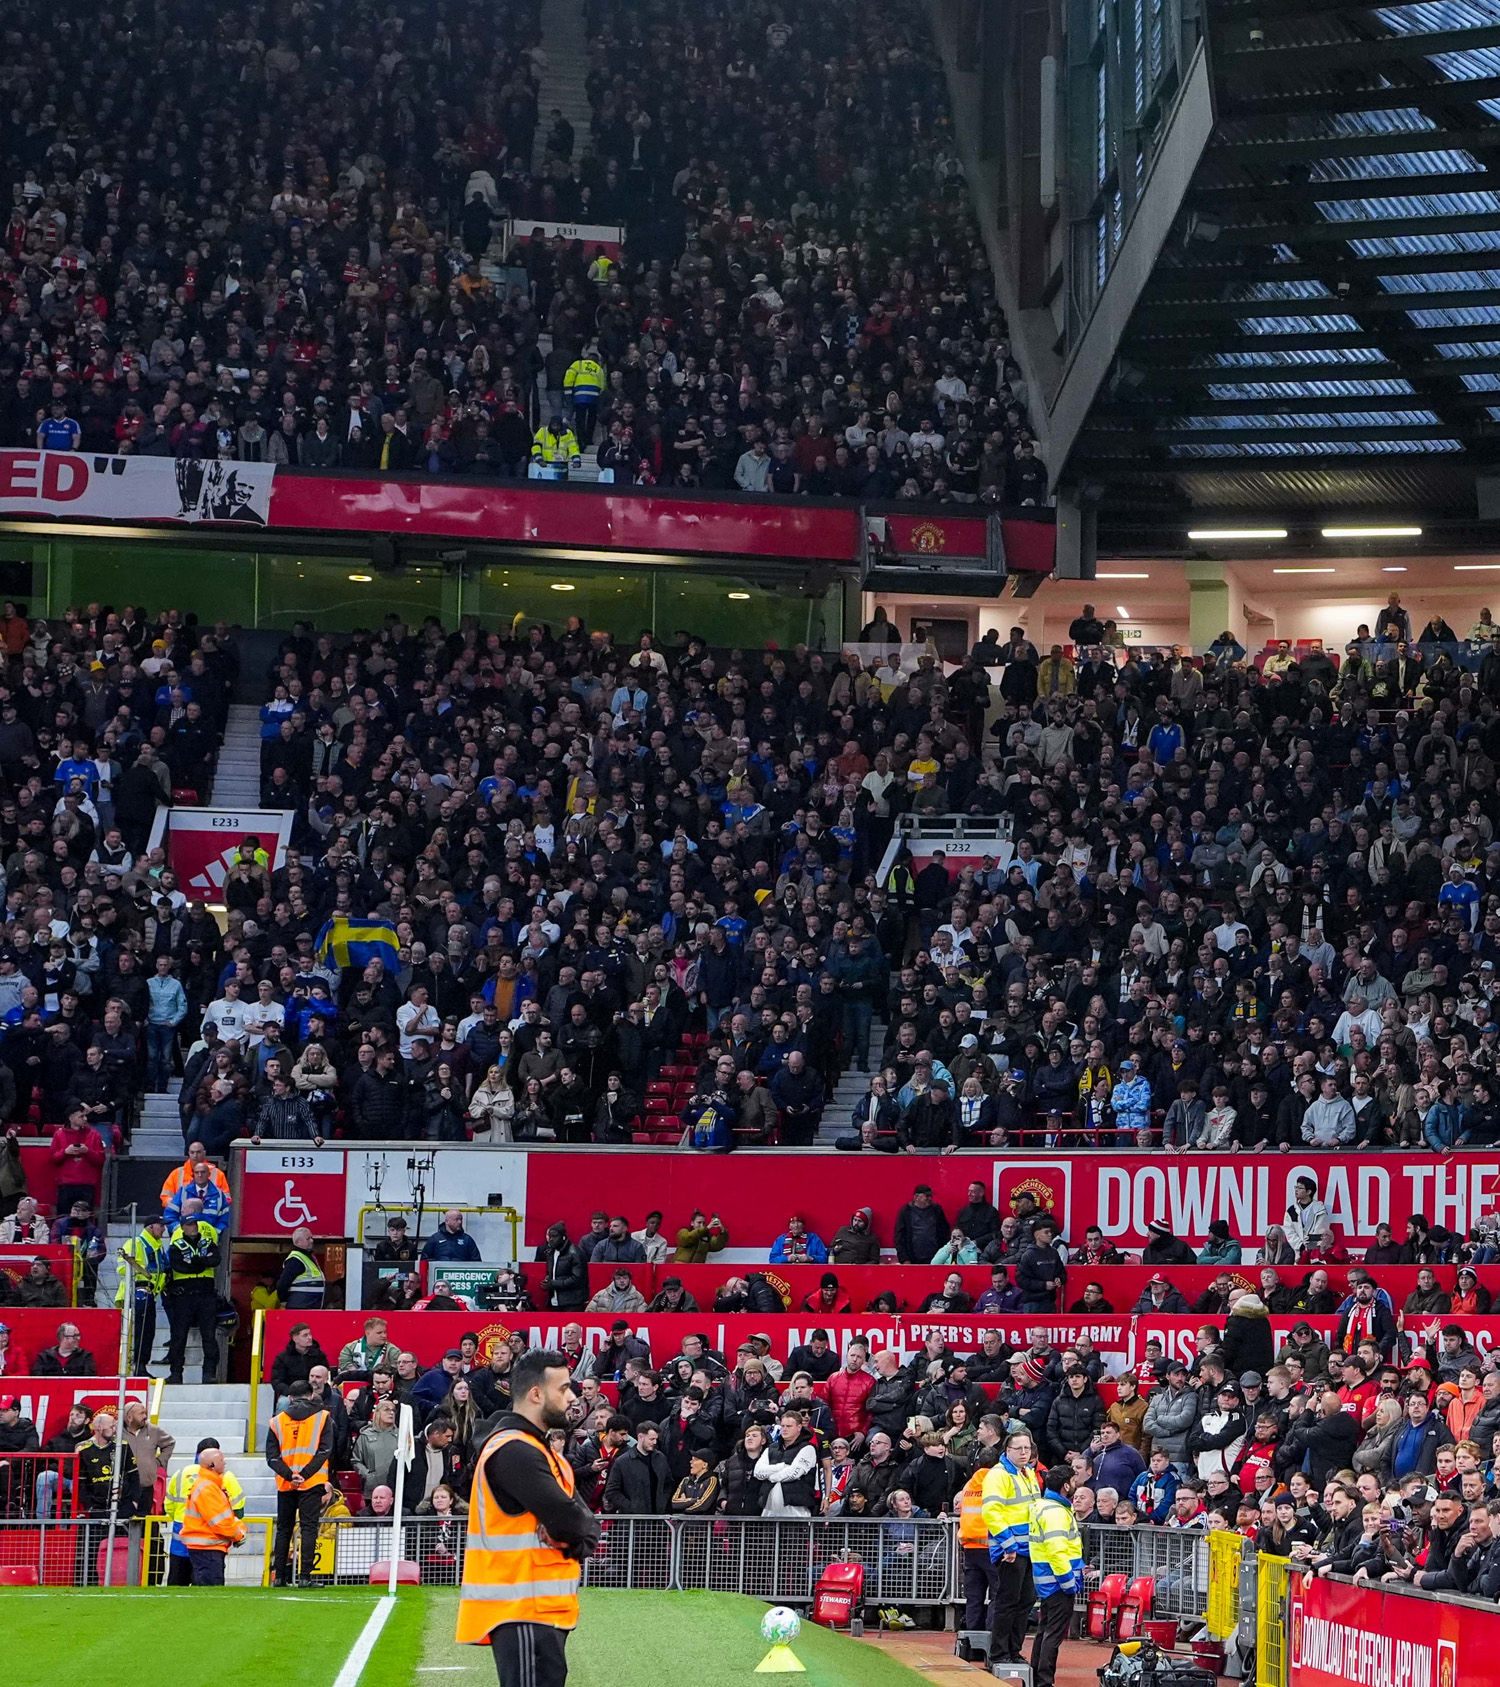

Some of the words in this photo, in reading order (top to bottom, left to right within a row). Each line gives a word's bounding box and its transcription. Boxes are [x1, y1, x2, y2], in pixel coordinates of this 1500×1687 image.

[212, 817, 240, 828] E233
[945, 843, 971, 853] E232
[281, 1156, 315, 1168] E133
[1013, 1182, 1050, 1197] MANCHESTER
[1403, 1164, 1499, 1236] THE
[443, 1272, 492, 1281] EMERGENCY
[910, 1324, 973, 1344] PETER'S
[977, 1328, 1006, 1344] RD
[1010, 1330, 1022, 1345] &
[1080, 1325, 1122, 1343] ARMY
[820, 1595, 852, 1606] STEWARDS
[1302, 1615, 1344, 1677] DOWNLOAD
[1344, 1625, 1359, 1682] THE
[1358, 1629, 1394, 1687] OFFICIAL
[1394, 1639, 1412, 1687] APP
[1412, 1643, 1433, 1687] NOW
